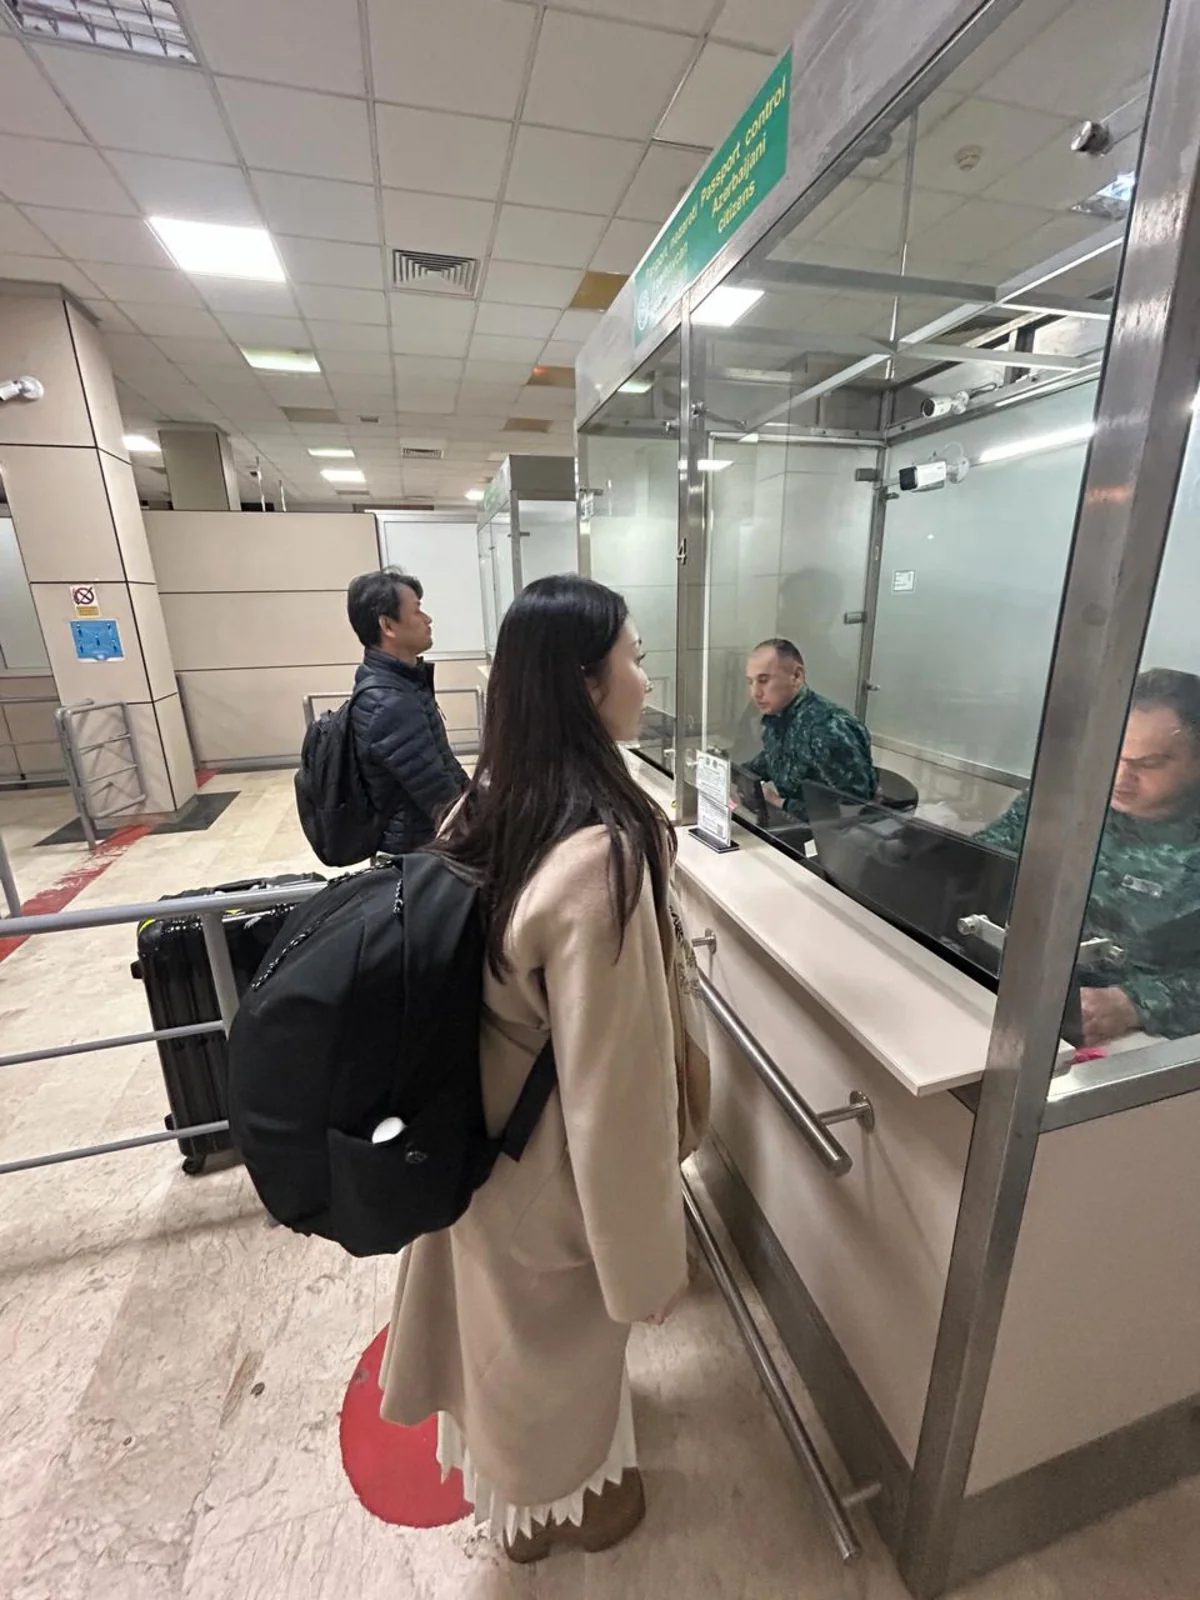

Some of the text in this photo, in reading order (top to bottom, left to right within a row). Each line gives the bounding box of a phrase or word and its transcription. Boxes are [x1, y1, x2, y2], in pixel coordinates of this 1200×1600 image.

[701, 75, 786, 208] Passport control
[711, 131, 766, 218] Azerbaijani
[718, 180, 755, 233] citizens
[676, 538, 687, 566] 4
